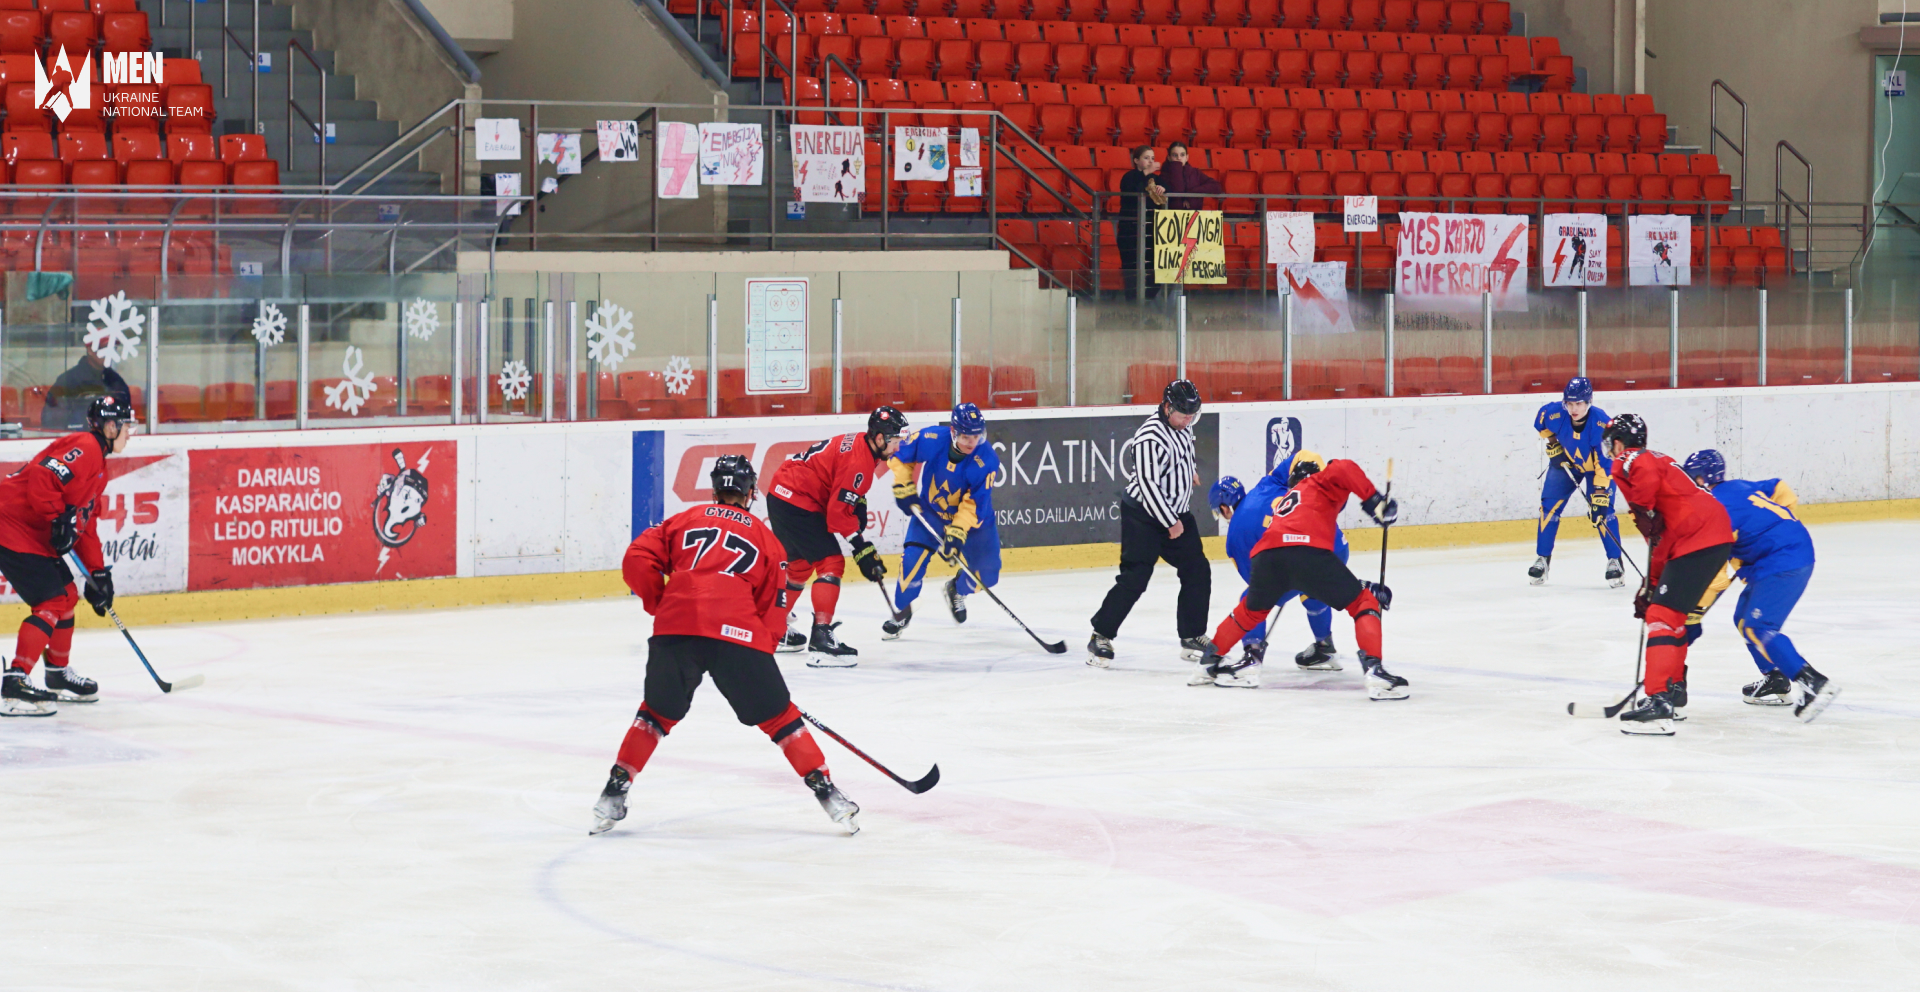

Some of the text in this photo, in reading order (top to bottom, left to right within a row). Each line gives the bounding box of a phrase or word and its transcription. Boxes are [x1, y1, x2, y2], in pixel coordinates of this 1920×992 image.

[795, 131, 864, 155] ENERGIJA
[793, 203, 799, 213] 2
[1346, 214, 1377, 226] ENERGIJA
[1398, 215, 1440, 257] MES
[63, 447, 83, 463] 5
[238, 466, 321, 488] DARIAUS
[723, 475, 734, 487] 77
[853, 472, 864, 490] 8
[100, 491, 161, 533] 45
[215, 488, 342, 515] KASPARAIČIO
[995, 508, 1031, 526] ISKAS
[1035, 505, 1105, 524] DAILIAJAM
[270, 517, 343, 539] RITULIO
[232, 543, 325, 566] MOKYKLA
[682, 527, 760, 577] 77
[729, 627, 750, 640] IIHF
